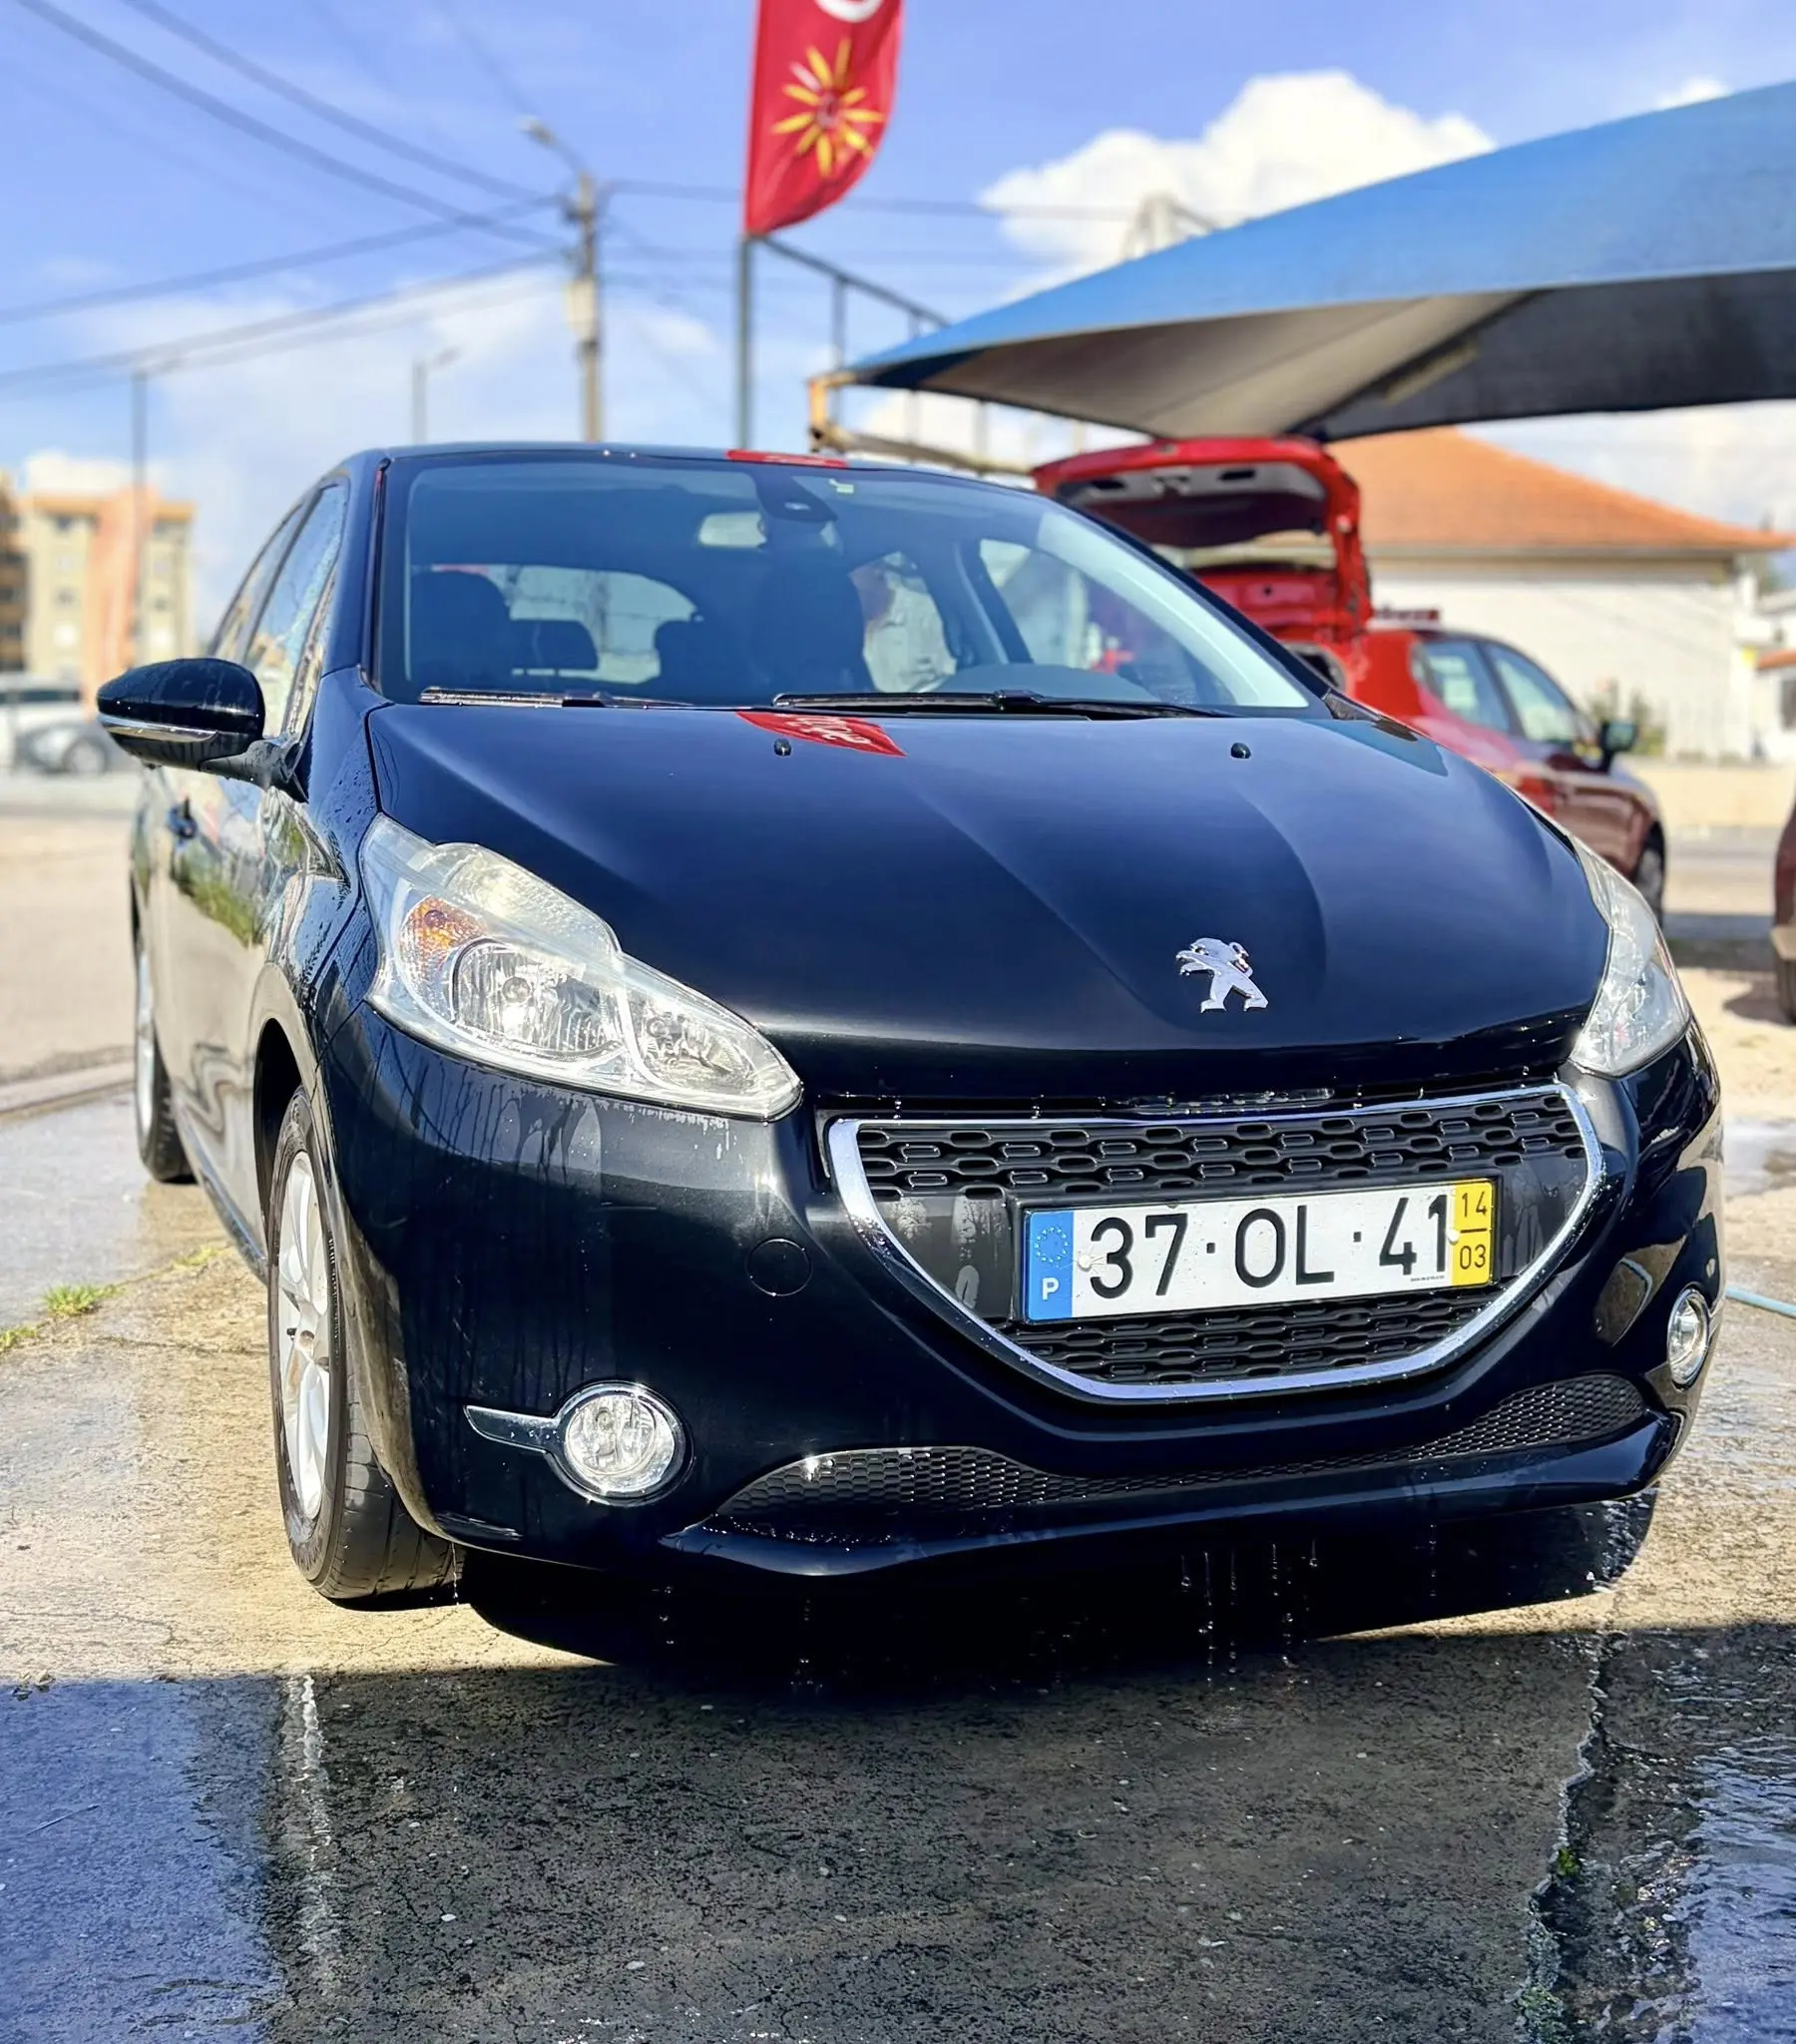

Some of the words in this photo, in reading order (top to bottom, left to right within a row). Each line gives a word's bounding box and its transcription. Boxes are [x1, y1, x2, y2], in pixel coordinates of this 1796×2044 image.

[1461, 1191, 1488, 1218] 14
[1459, 1244, 1486, 1270] 03
[1043, 1277, 1060, 1301] P
